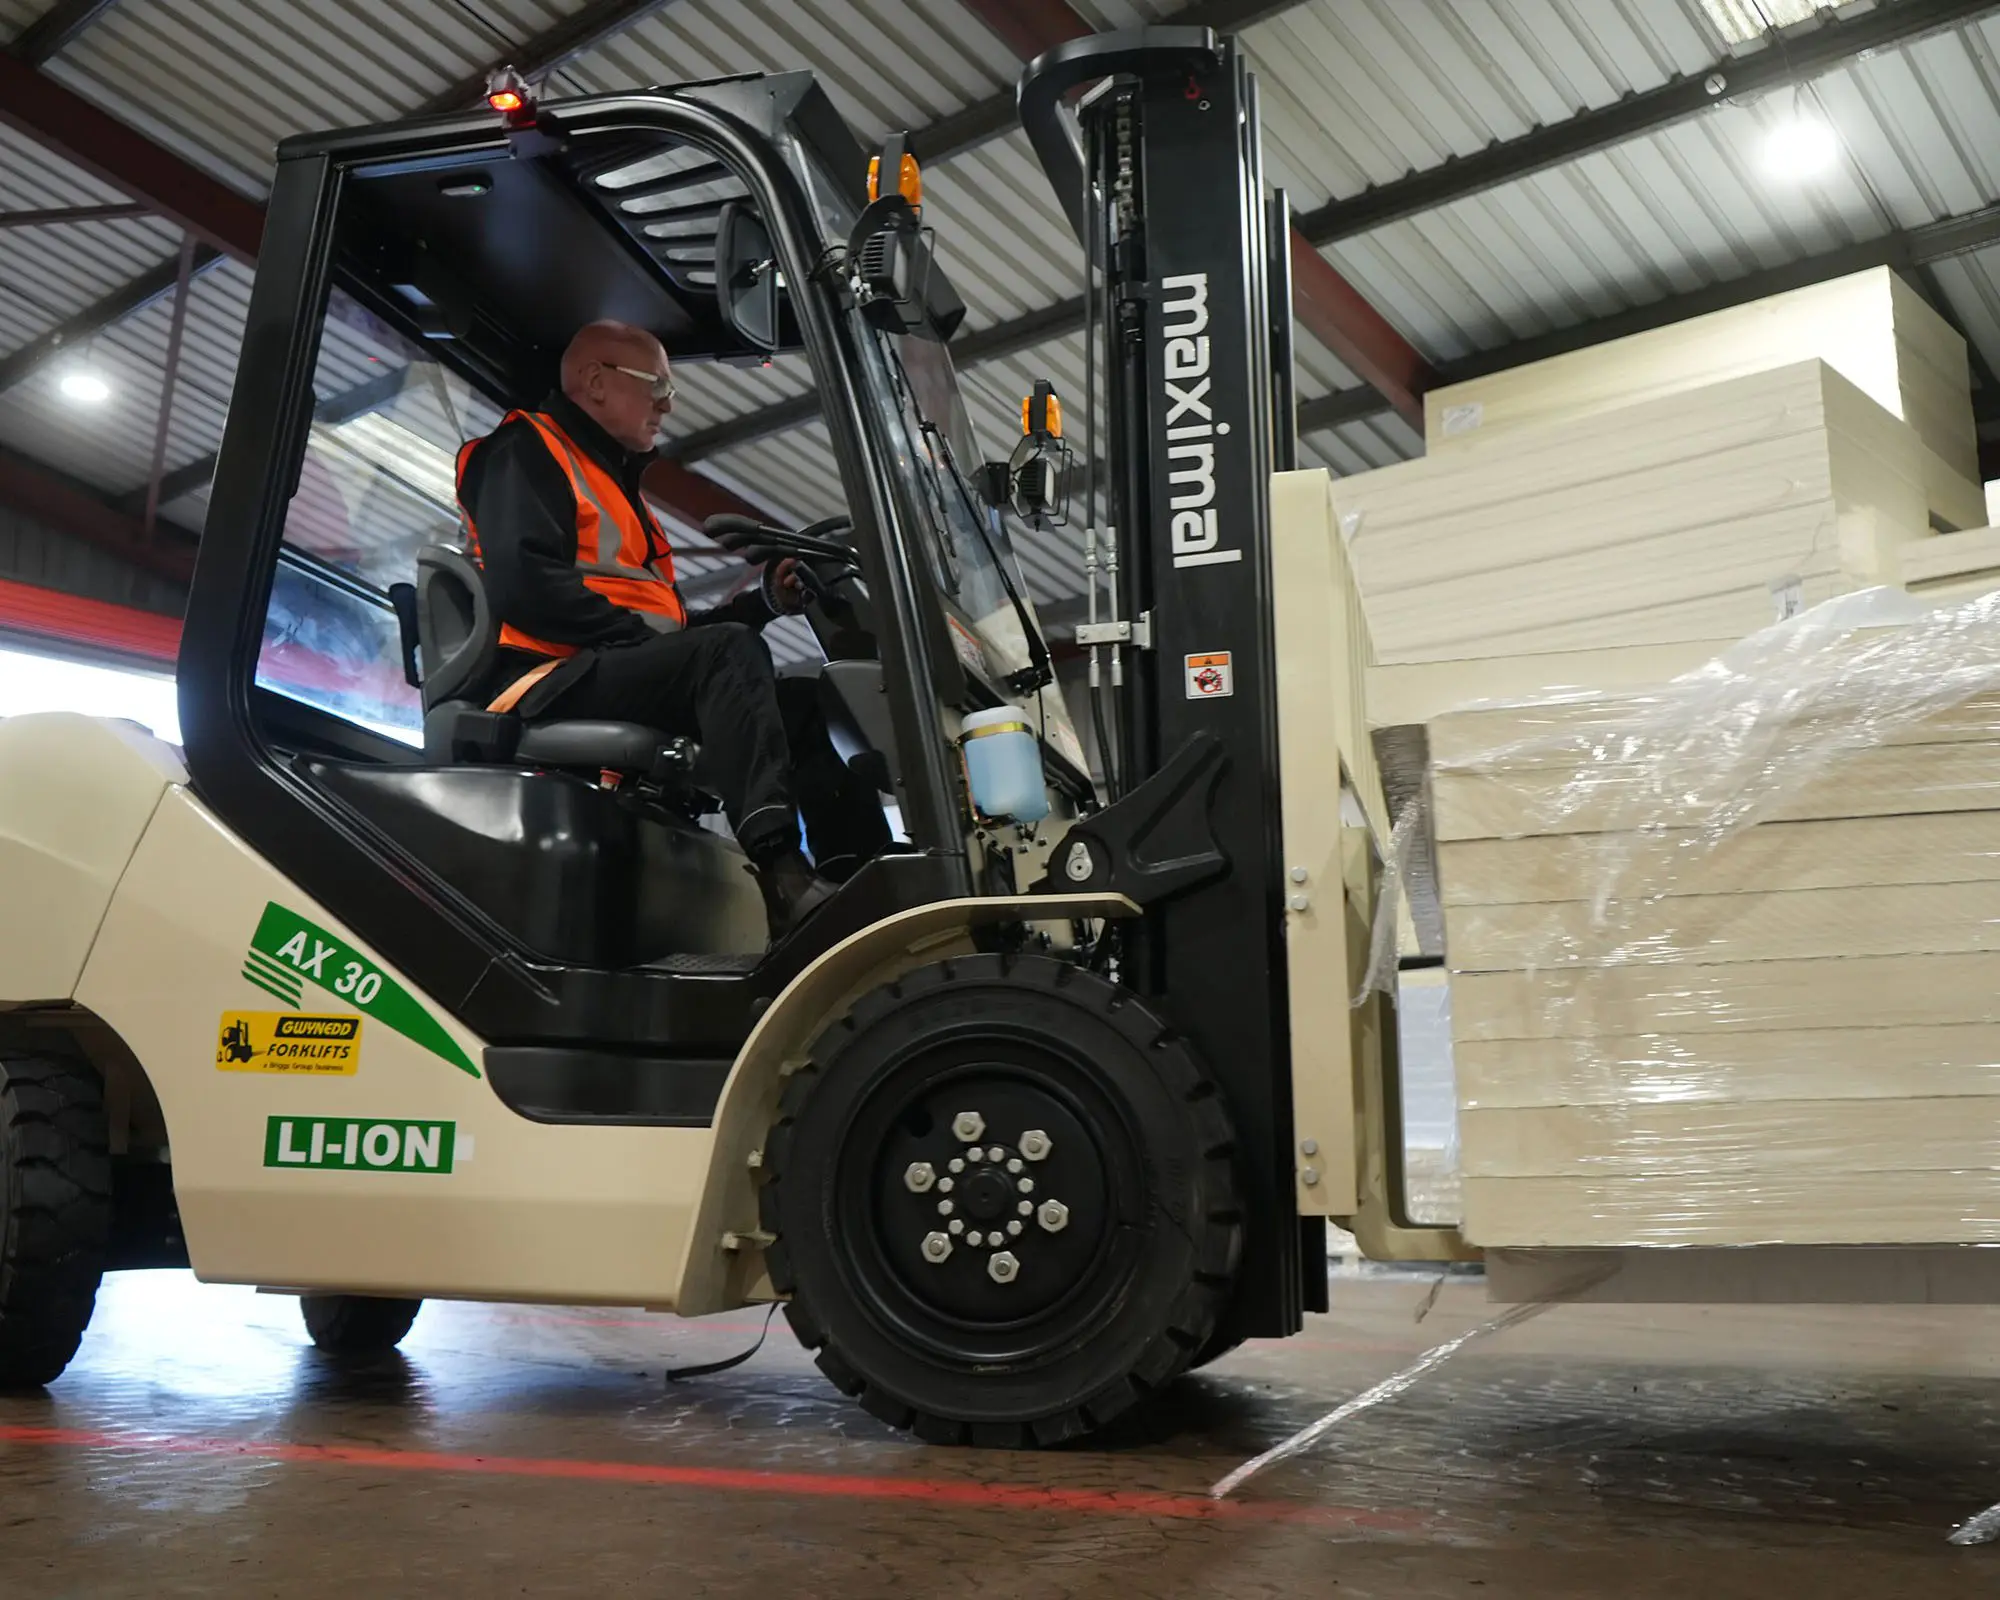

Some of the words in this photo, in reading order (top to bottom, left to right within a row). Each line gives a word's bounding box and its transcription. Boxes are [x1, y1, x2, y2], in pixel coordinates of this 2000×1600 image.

[1162, 273, 1242, 568] maximal
[275, 930, 338, 980] AX
[333, 962, 383, 1005] 30
[266, 1043, 351, 1059] FORKLIFTS
[281, 1020, 352, 1036] GWYNEDD
[276, 1121, 442, 1168] LI-ION
